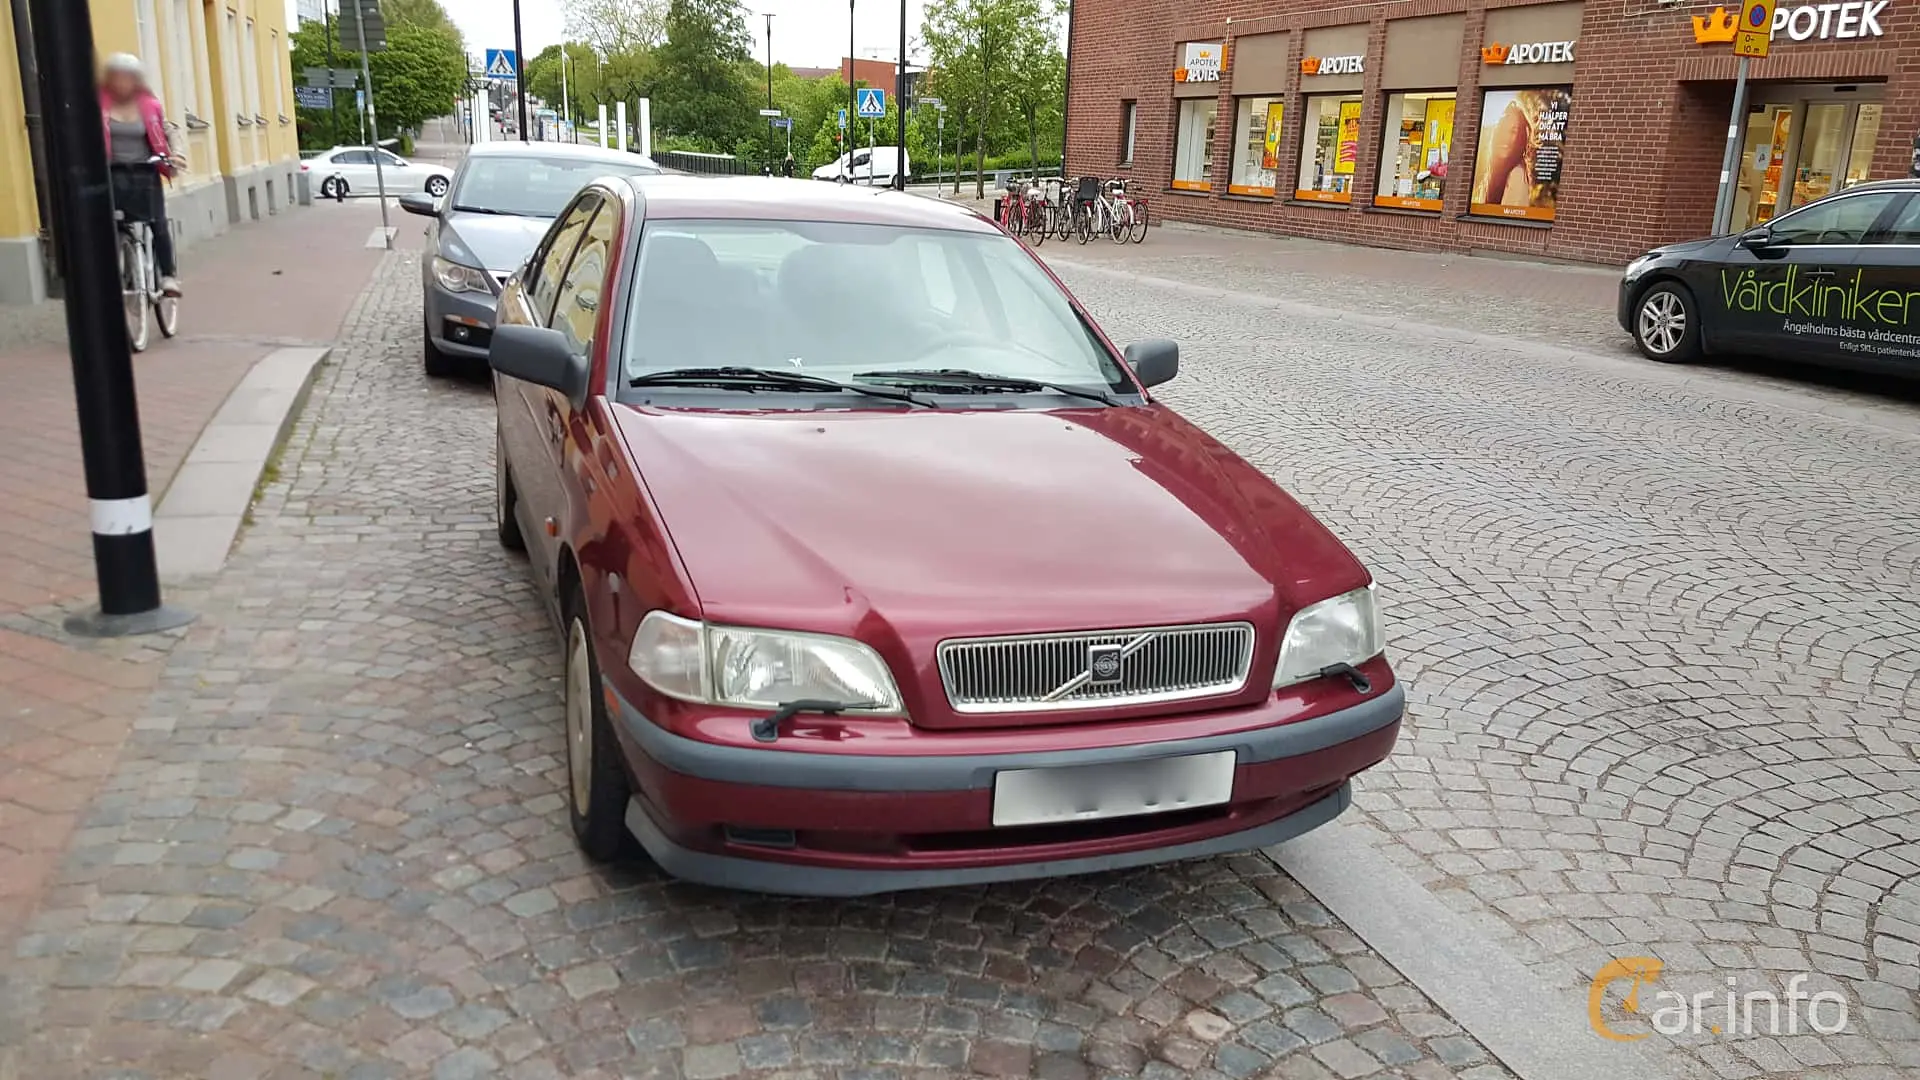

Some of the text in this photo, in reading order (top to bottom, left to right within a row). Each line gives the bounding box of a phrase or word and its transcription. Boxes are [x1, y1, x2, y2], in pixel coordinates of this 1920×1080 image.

[1770, 0, 1890, 41] POTEK
[1505, 41, 1576, 65] APOTEK
[1743, 45, 1752, 53] 10
[1189, 58, 1219, 67] APOTEK
[1317, 55, 1364, 75] APOTEK
[1185, 67, 1220, 83] APOTEK
[1550, 101, 1558, 111] VI
[1539, 121, 1566, 131] DIG ATT
[1550, 132, 1563, 141] BRA
[1783, 318, 1838, 335] Ängelholms
[1839, 324, 1866, 339] bästa
